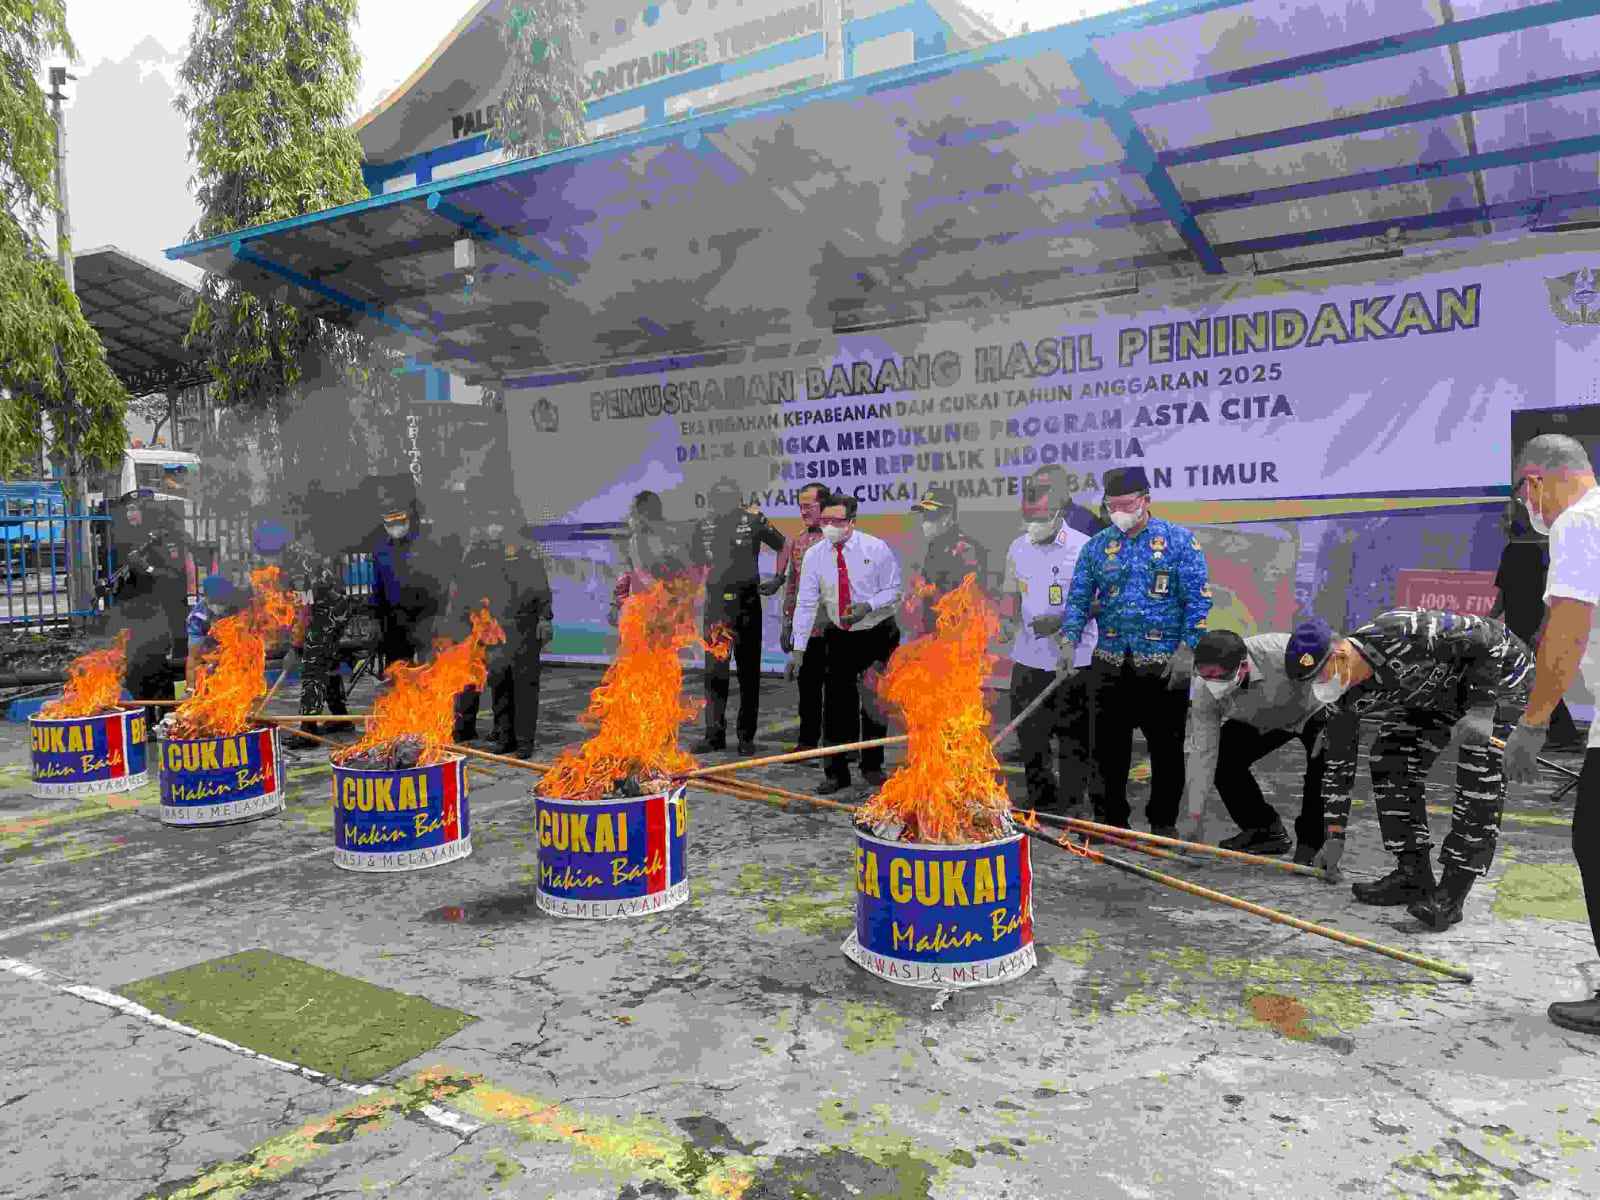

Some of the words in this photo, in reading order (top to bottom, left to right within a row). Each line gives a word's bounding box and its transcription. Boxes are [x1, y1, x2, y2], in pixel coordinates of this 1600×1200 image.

[805, 350, 961, 401] BARANG
[974, 333, 1104, 385] HASIL
[1118, 283, 1482, 368] PENINDAKAN
[784, 402, 892, 428] KEPABEANAN
[895, 397, 934, 417] DAN
[939, 391, 1000, 414] CUKAI
[1005, 384, 1073, 409] TAHUN
[1079, 369, 1209, 401] ANGGARAN
[1218, 362, 1282, 386] 2025
[836, 422, 982, 452] MENDUKUNG
[989, 408, 1123, 441] PROGRAM
[1133, 402, 1210, 428] ASTA
[1220, 394, 1294, 421] CITA
[768, 456, 868, 482] PRESIDEN
[874, 449, 984, 476] REPUBLIK
[994, 437, 1145, 467] INDONESIA
[851, 480, 917, 503] CUKAI
[1183, 461, 1280, 488] TIMUR
[1420, 592, 1461, 611] 100%
[31, 725, 94, 753] CUKAI
[168, 736, 248, 771] CUKAI
[80, 749, 122, 773] Baik
[172, 780, 231, 801] Makin
[235, 762, 272, 790] Baik
[342, 774, 428, 812] CUKAI
[344, 822, 407, 846] Makin
[413, 806, 457, 838] Baik
[538, 809, 628, 853] CUKAI
[540, 860, 603, 890] Makin
[610, 850, 663, 886] Baik
[889, 854, 1007, 907] CUKAI
[561, 902, 569, 912] &
[893, 921, 983, 953] Makin
[931, 966, 943, 983] &
